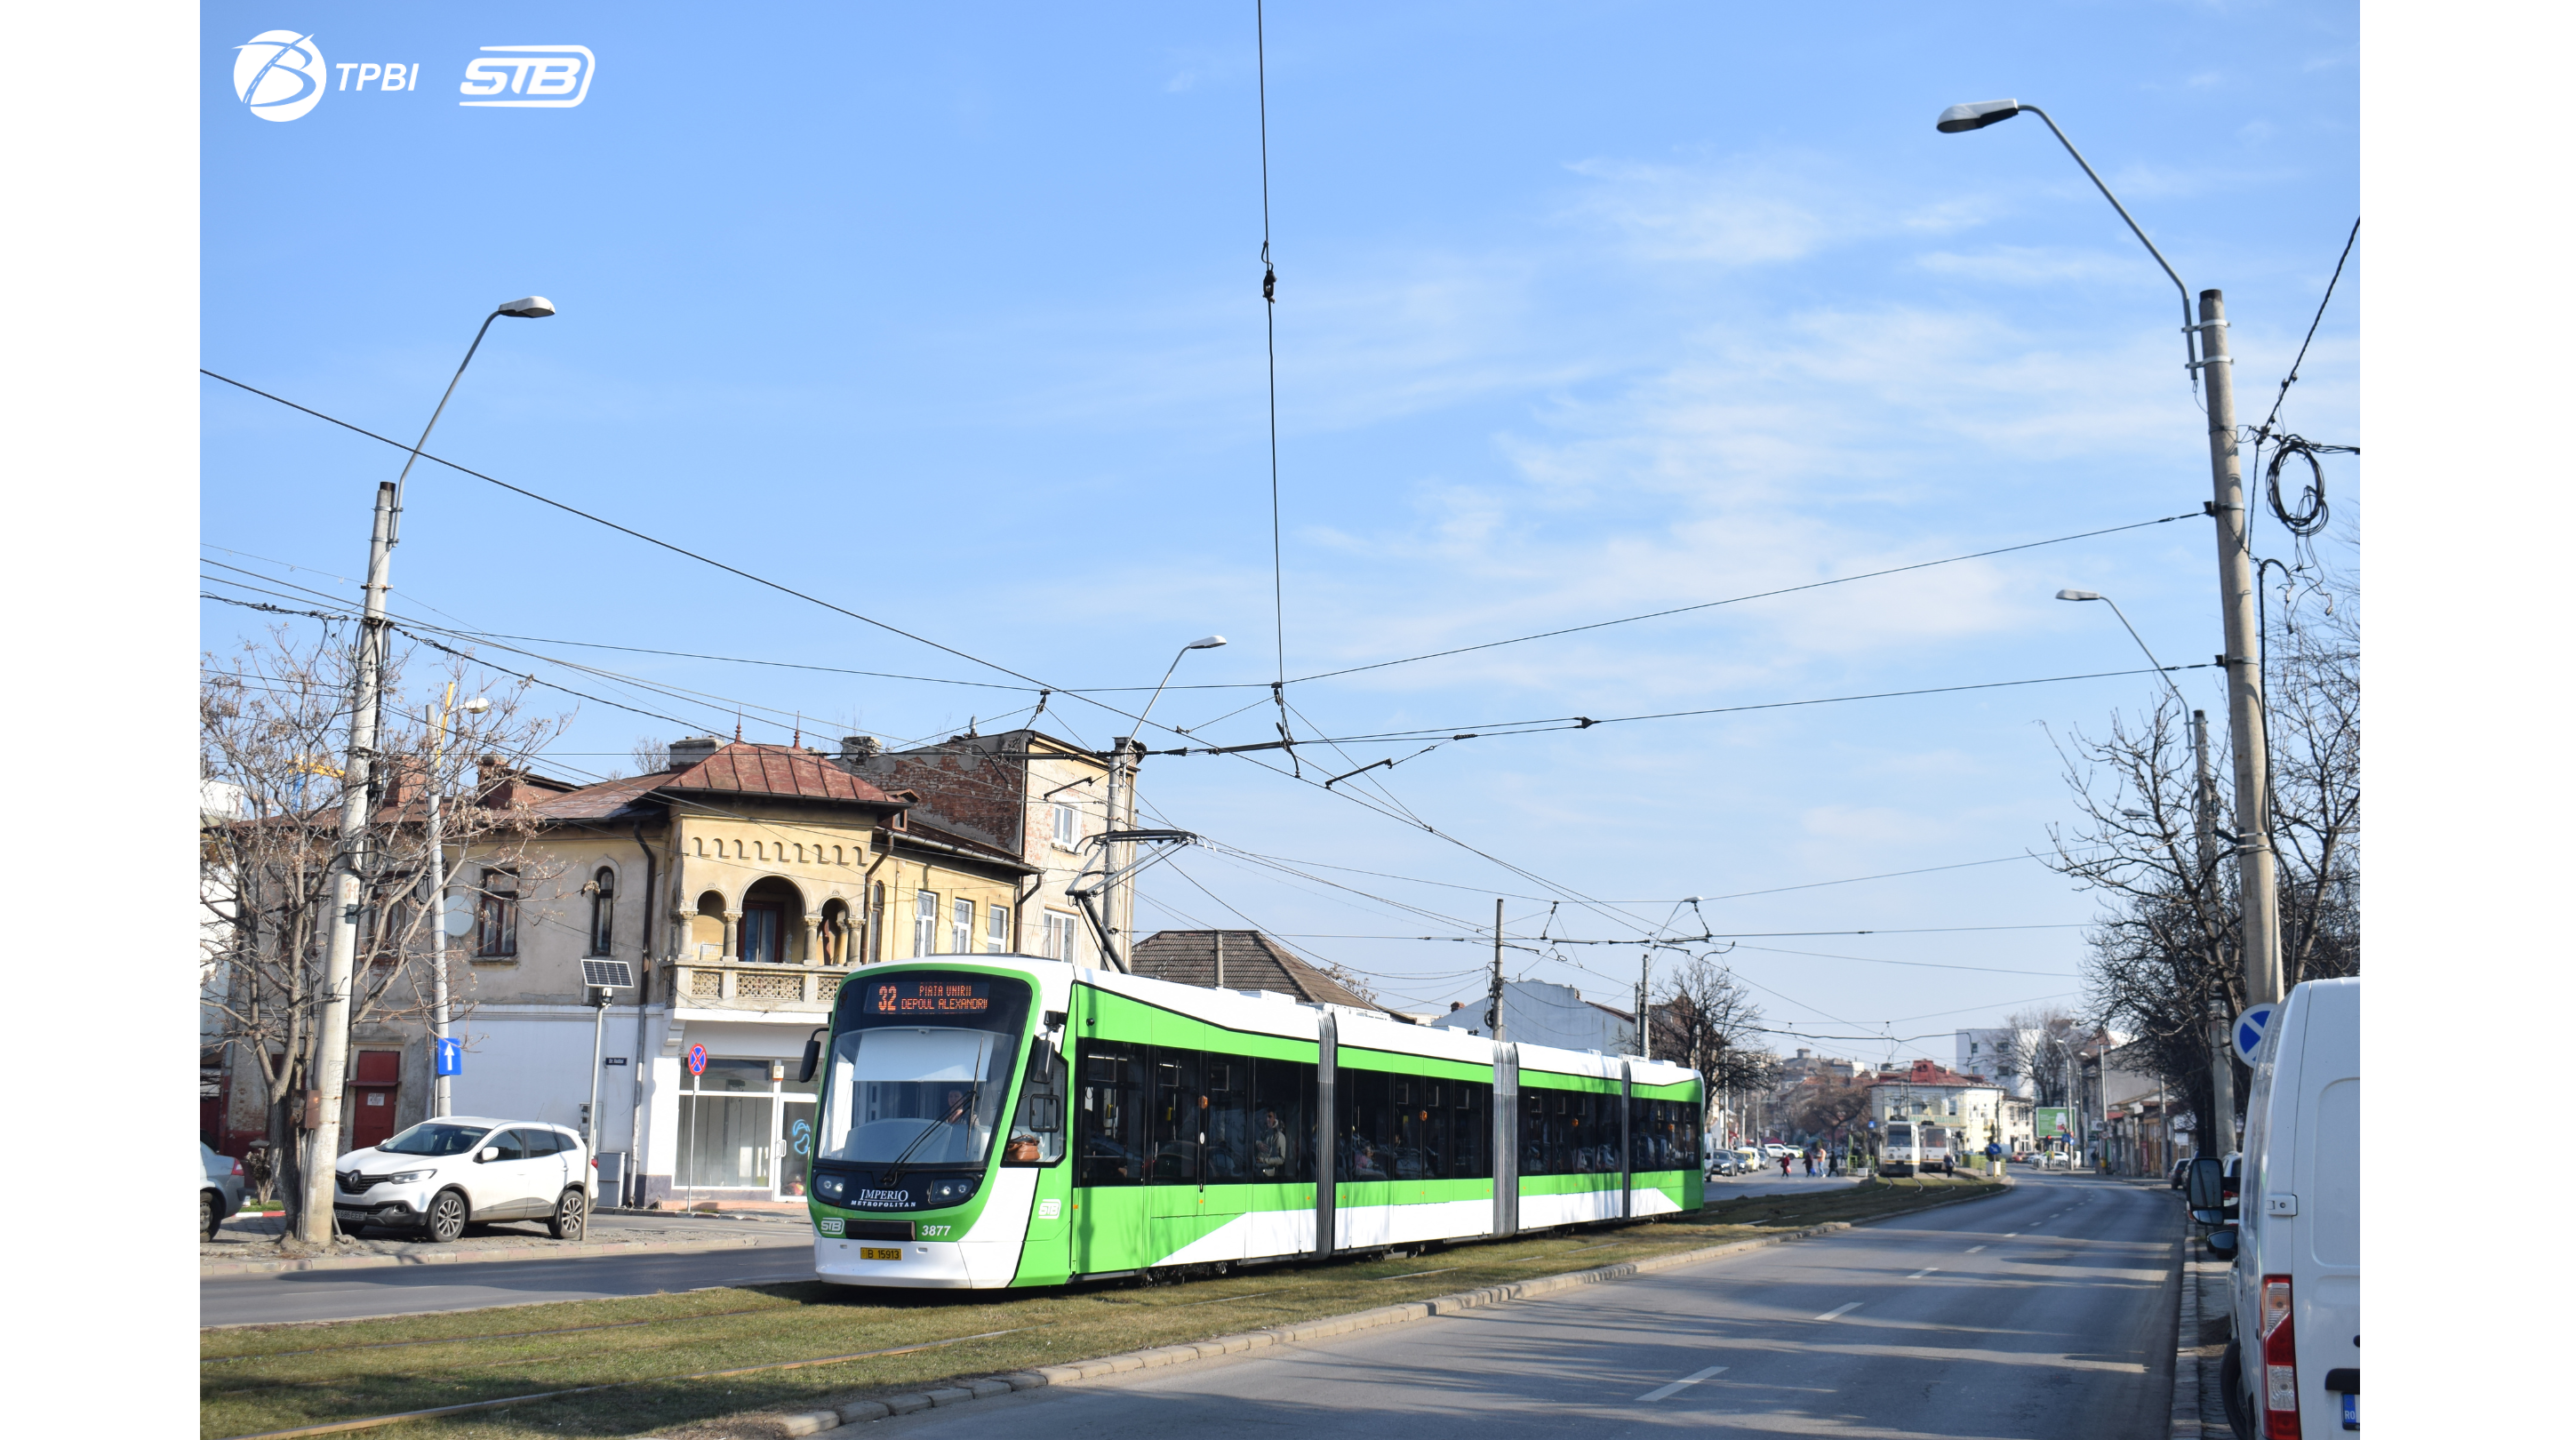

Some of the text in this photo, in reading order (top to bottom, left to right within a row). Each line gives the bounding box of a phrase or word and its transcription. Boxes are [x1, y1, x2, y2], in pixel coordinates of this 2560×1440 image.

[919, 985, 972, 997] PIATA UNIRII
[878, 985, 897, 1011] 32
[901, 998, 935, 1010] DEPOUL
[859, 1189, 909, 1202] IMPERIO
[850, 1200, 917, 1208] METROPOLITAN
[1038, 1201, 1060, 1217] STB
[821, 1219, 843, 1232] STB
[921, 1225, 952, 1236] 3877
[867, 1249, 874, 1259] B
[877, 1249, 900, 1260] 15913
[2344, 1410, 2356, 1420] RO
